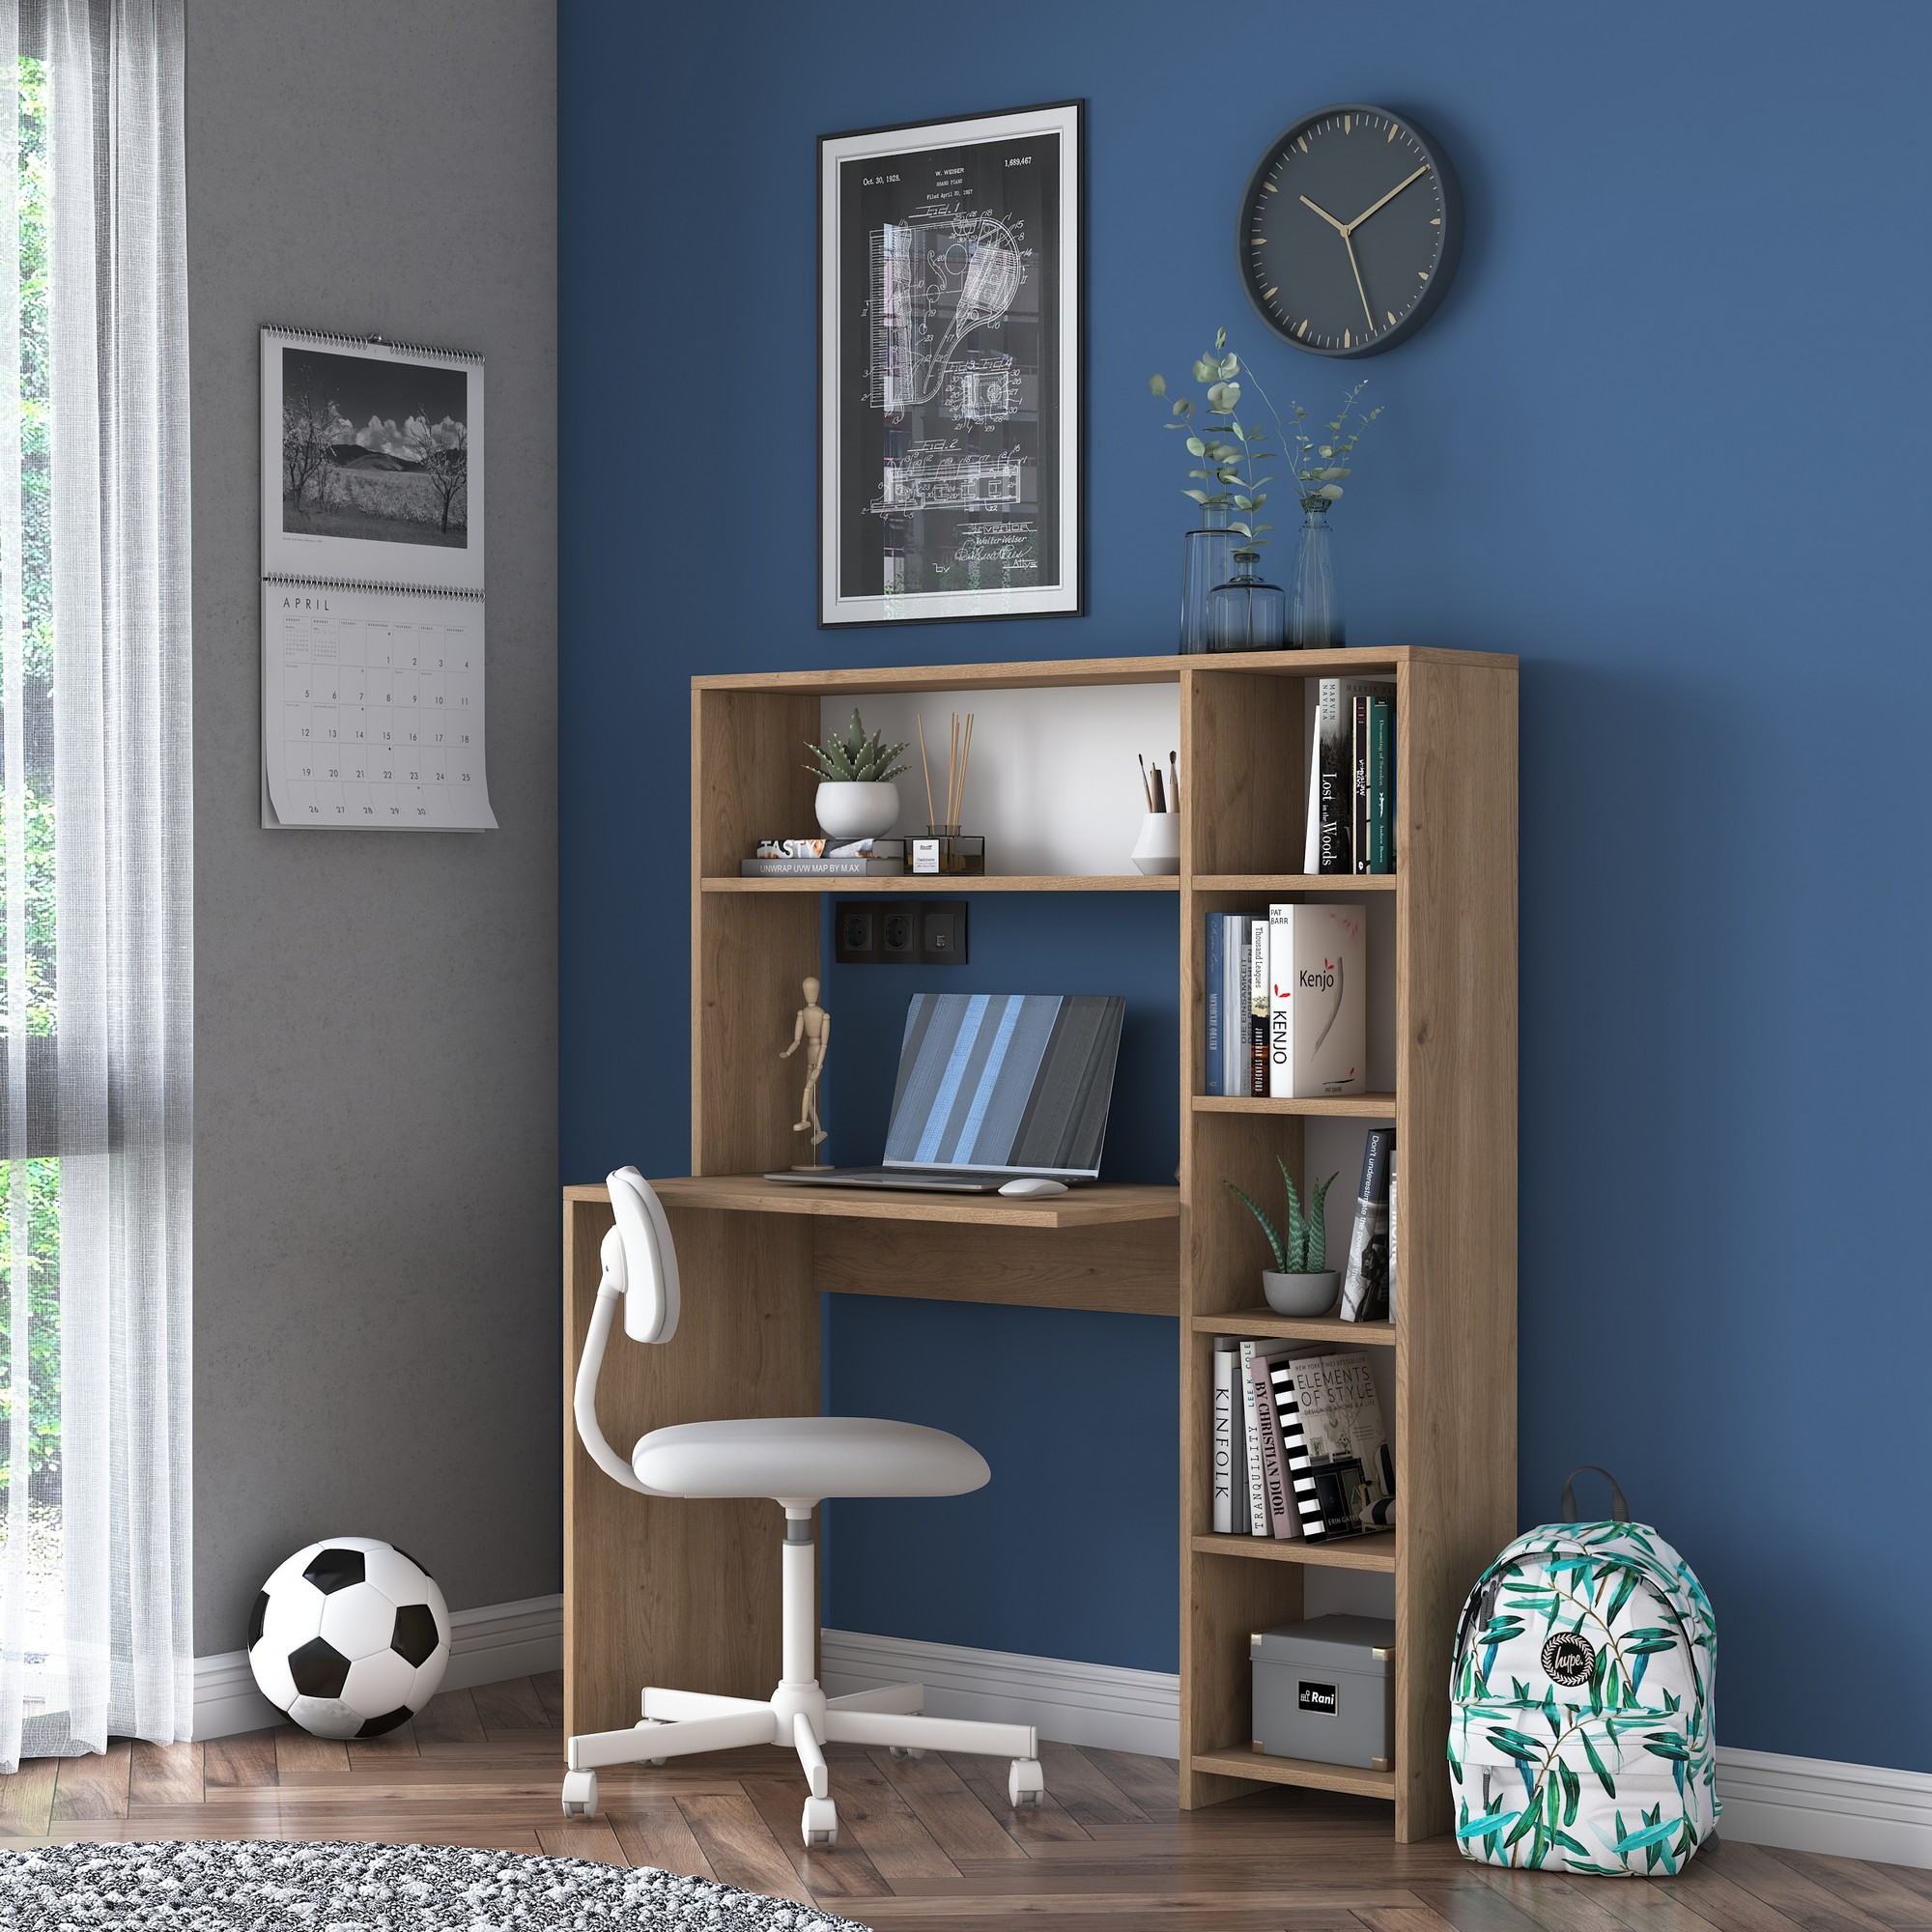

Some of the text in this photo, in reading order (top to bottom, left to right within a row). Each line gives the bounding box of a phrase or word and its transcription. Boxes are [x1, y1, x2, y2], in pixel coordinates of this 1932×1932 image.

[1005, 156, 1032, 168] 1,689,467
[863, 174, 901, 186] Oct. 30, 1928.
[944, 168, 965, 176] WEISER
[940, 191, 953, 199] April
[949, 438, 958, 448] 2
[1002, 535, 1027, 543] Weiser
[282, 597, 329, 611] APRIL
[413, 657, 417, 666] 2
[305, 689, 310, 698] 5
[360, 692, 364, 701] 7
[435, 696, 443, 705] 10
[383, 732, 391, 740] 15
[409, 733, 417, 741] 16
[461, 735, 469, 743] 18
[410, 771, 419, 780] 23
[1322, 773, 1337, 801] Lost
[761, 839, 816, 858] TASTY
[1322, 821, 1337, 866] Woods
[760, 865, 792, 873] UNWRAP
[841, 864, 859, 872] M.AX
[1254, 961, 1263, 988] Leagues
[1299, 970, 1334, 992] Kenjo
[1273, 1011, 1287, 1064] KENJO
[1255, 1059, 1263, 1092] STANDFORD
[1369, 1135, 1379, 1157] Don't
[1361, 1158, 1374, 1215] underestimate
[1355, 1231, 1363, 1257] power
[1297, 1366, 1369, 1390] ELEMENTS
[1301, 1383, 1373, 1406] OF STYLE
[1305, 1407, 1332, 1415] DESIGNING
[1216, 1388, 1229, 1499] KINFOLK
[1255, 1381, 1284, 1516] BY CHRISTIAN DIOR
[1249, 1426, 1264, 1529] TRANQUILITY
[1328, 1517, 1341, 1526] ERIN
[1555, 1646, 1583, 1674] hype.
[1312, 1691, 1334, 1705] Rani
